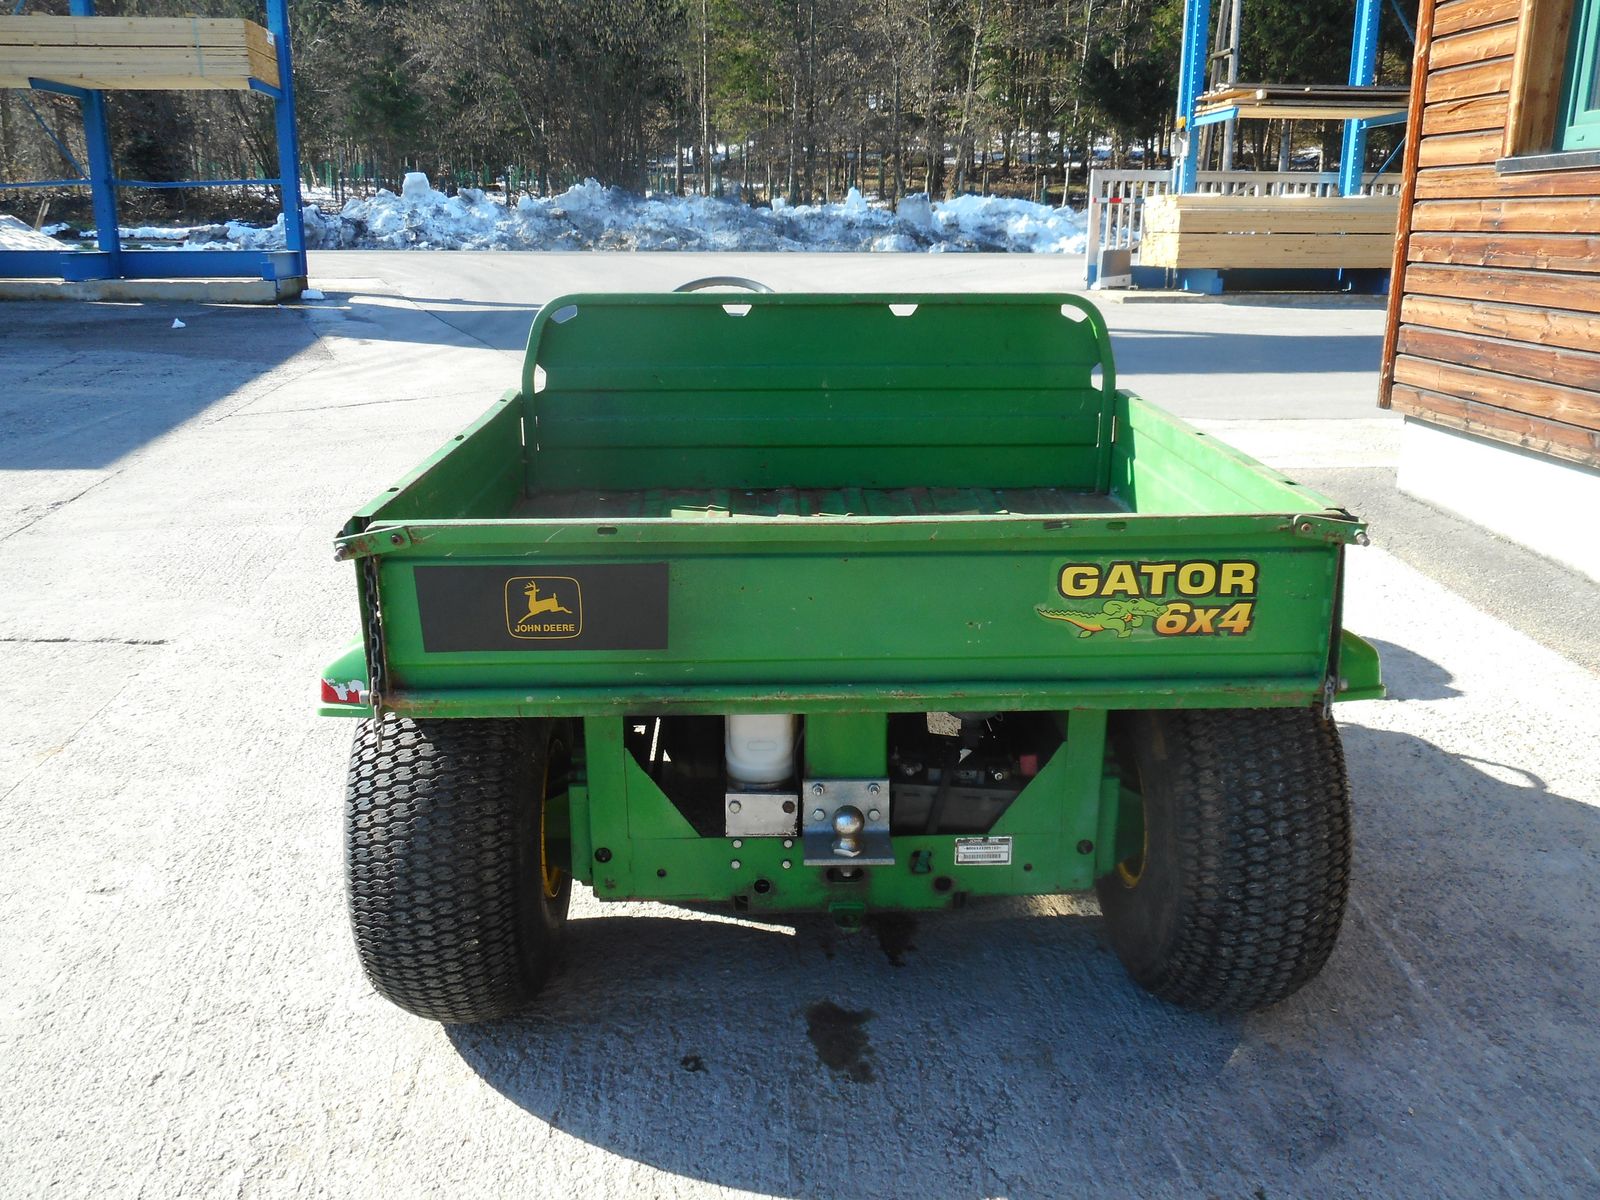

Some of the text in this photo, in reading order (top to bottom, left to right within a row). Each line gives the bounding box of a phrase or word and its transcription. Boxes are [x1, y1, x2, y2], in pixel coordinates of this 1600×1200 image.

[1060, 562, 1256, 597] GATOR
[515, 624, 575, 632] JOHN DEERE
